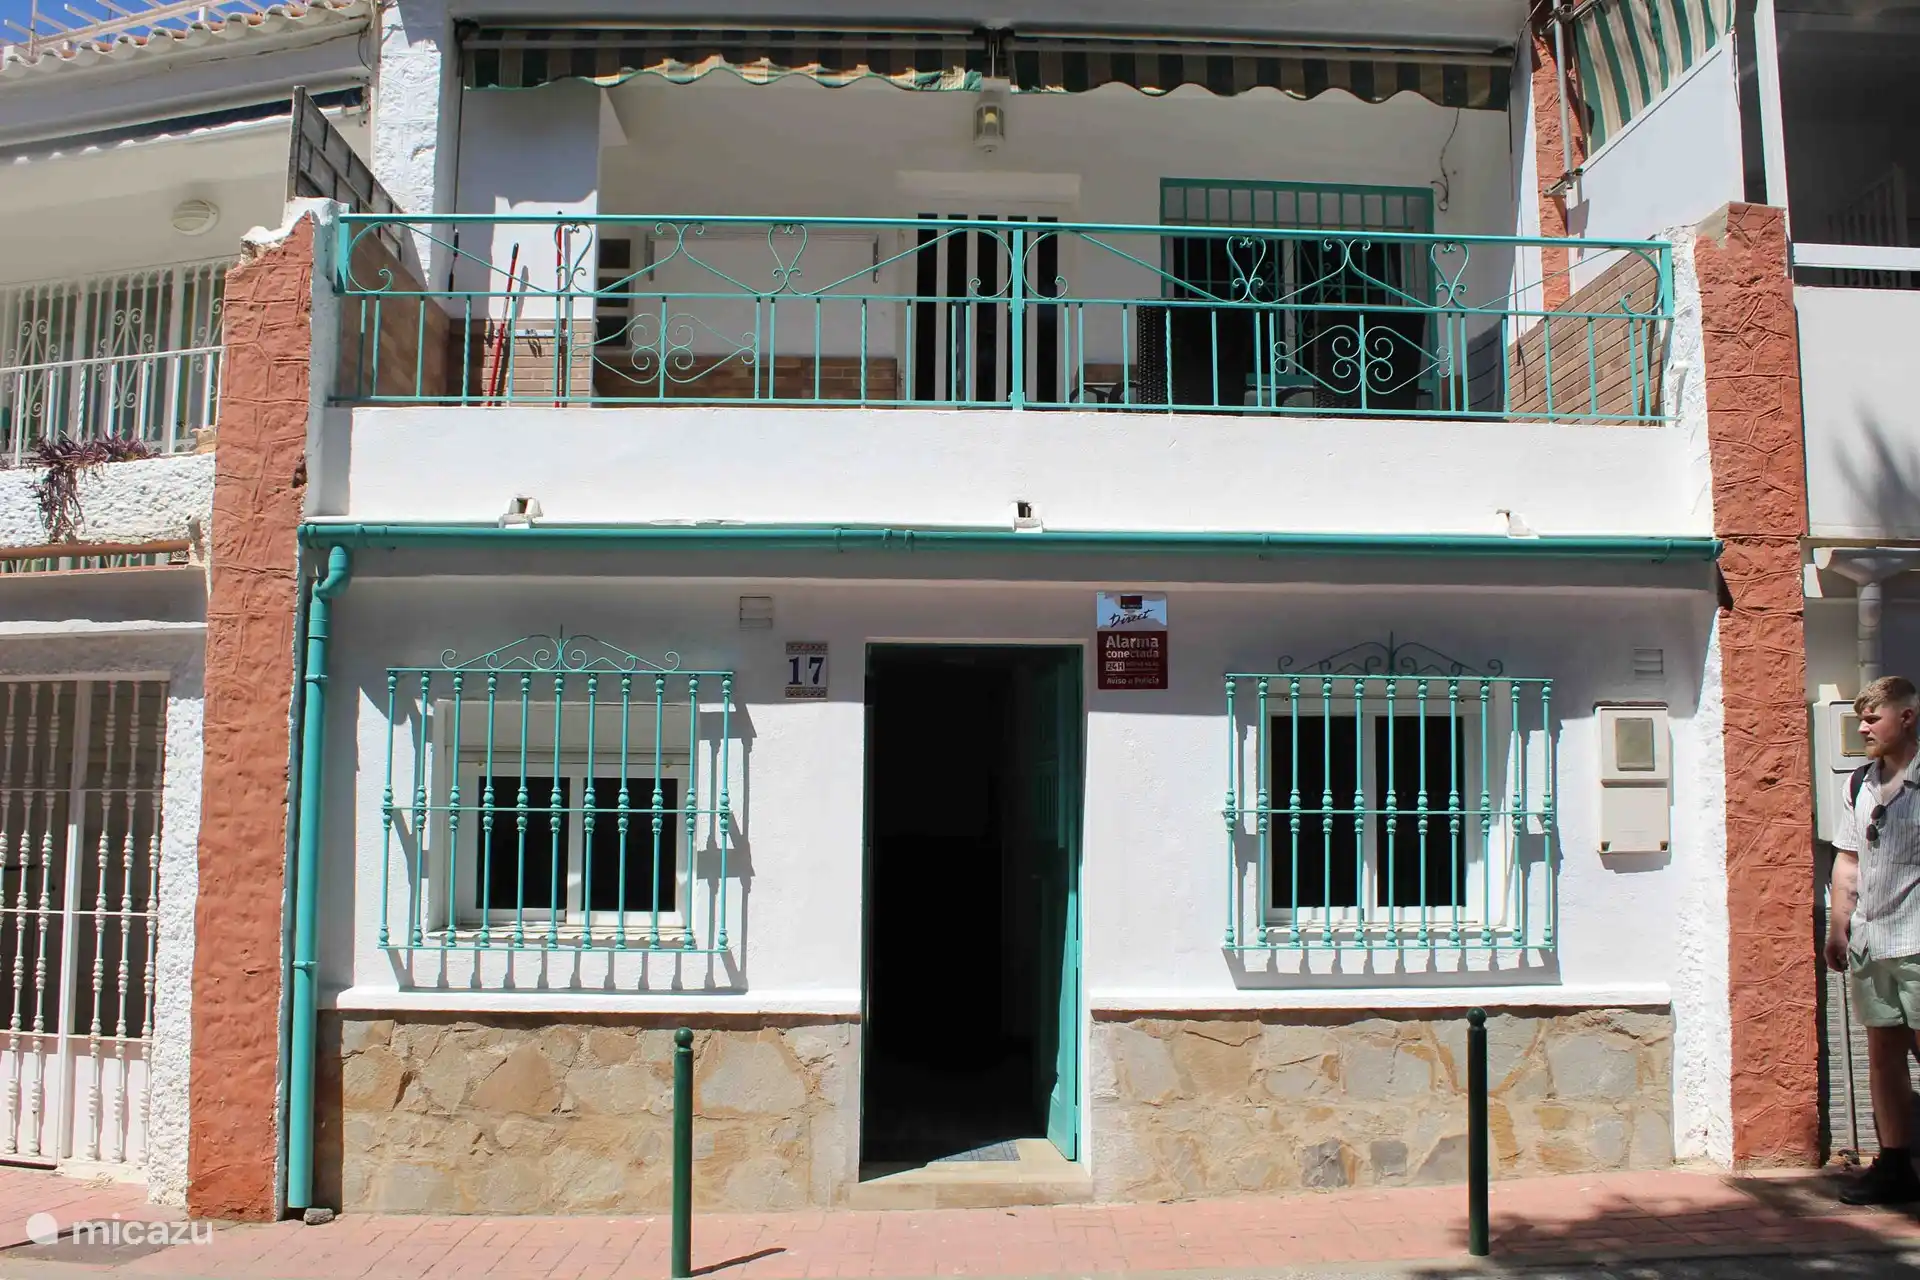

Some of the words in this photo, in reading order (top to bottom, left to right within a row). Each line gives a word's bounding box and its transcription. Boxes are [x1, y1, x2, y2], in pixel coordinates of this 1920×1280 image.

[1108, 609, 1154, 627] Direct
[1106, 634, 1159, 648] Alarma
[1106, 649, 1159, 658] conectada
[789, 656, 824, 685] 17
[1107, 662, 1124, 671] 24H
[1107, 676, 1126, 685] Aviso
